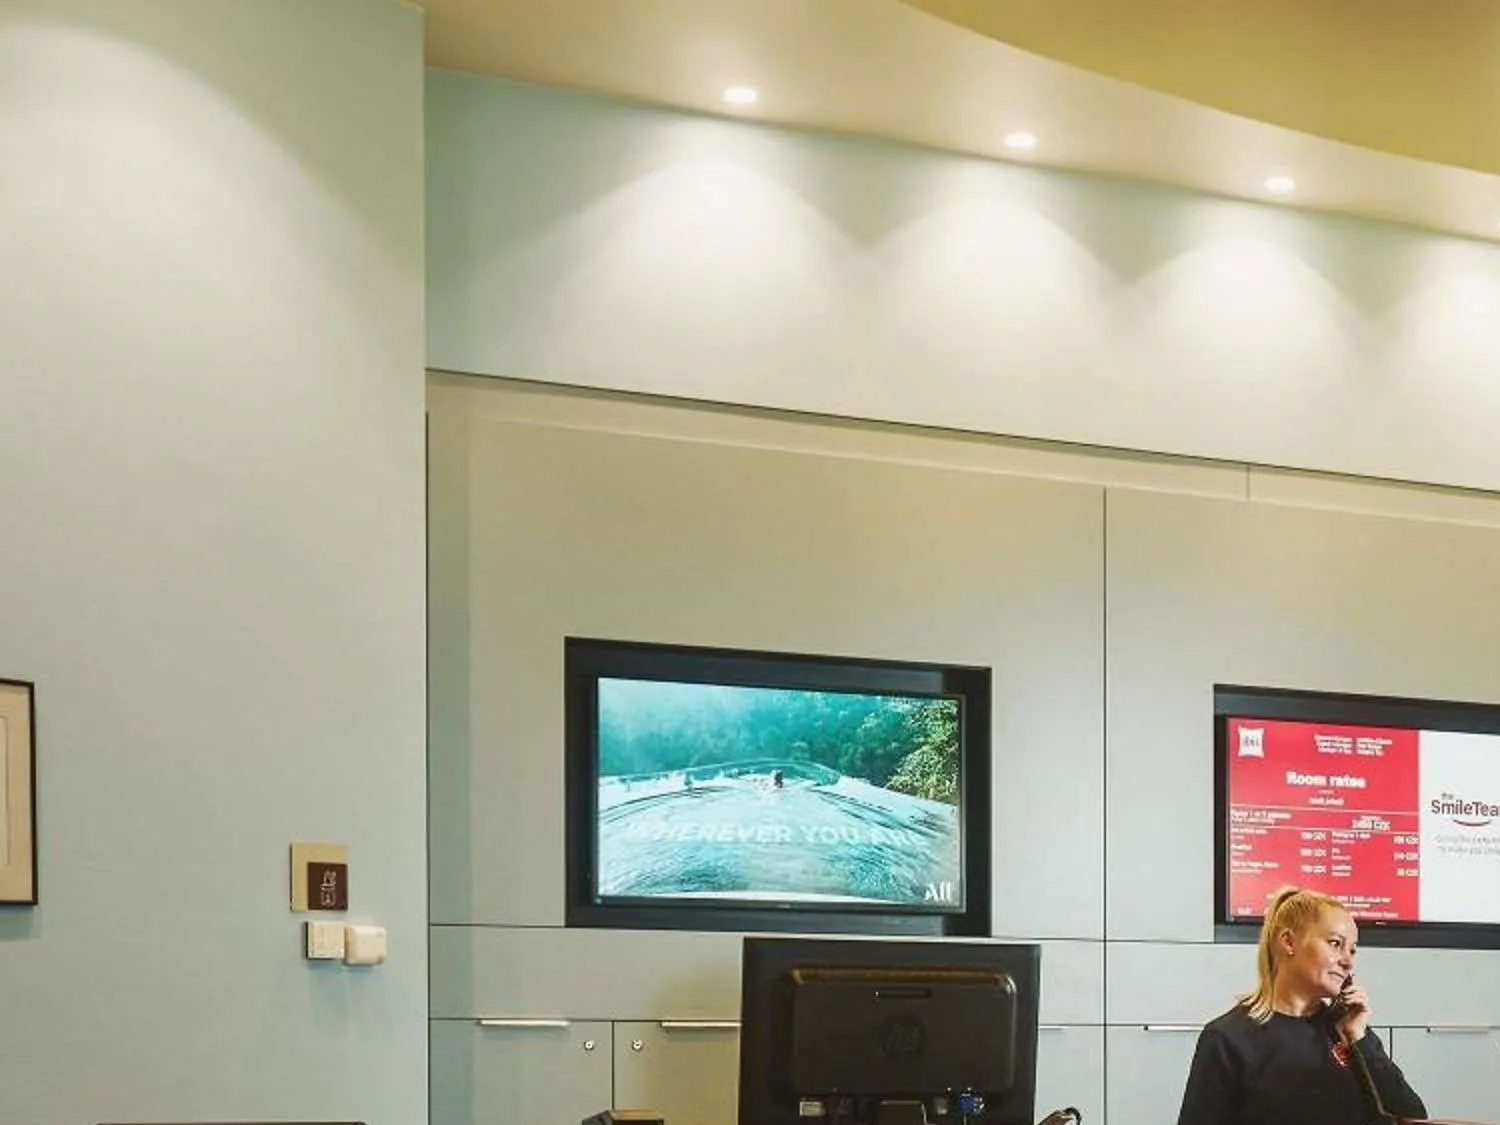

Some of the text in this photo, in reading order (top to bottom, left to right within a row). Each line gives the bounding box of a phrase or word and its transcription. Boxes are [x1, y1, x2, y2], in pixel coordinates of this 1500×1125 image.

[1285, 770, 1367, 788] Room rates
[925, 881, 952, 902] All
